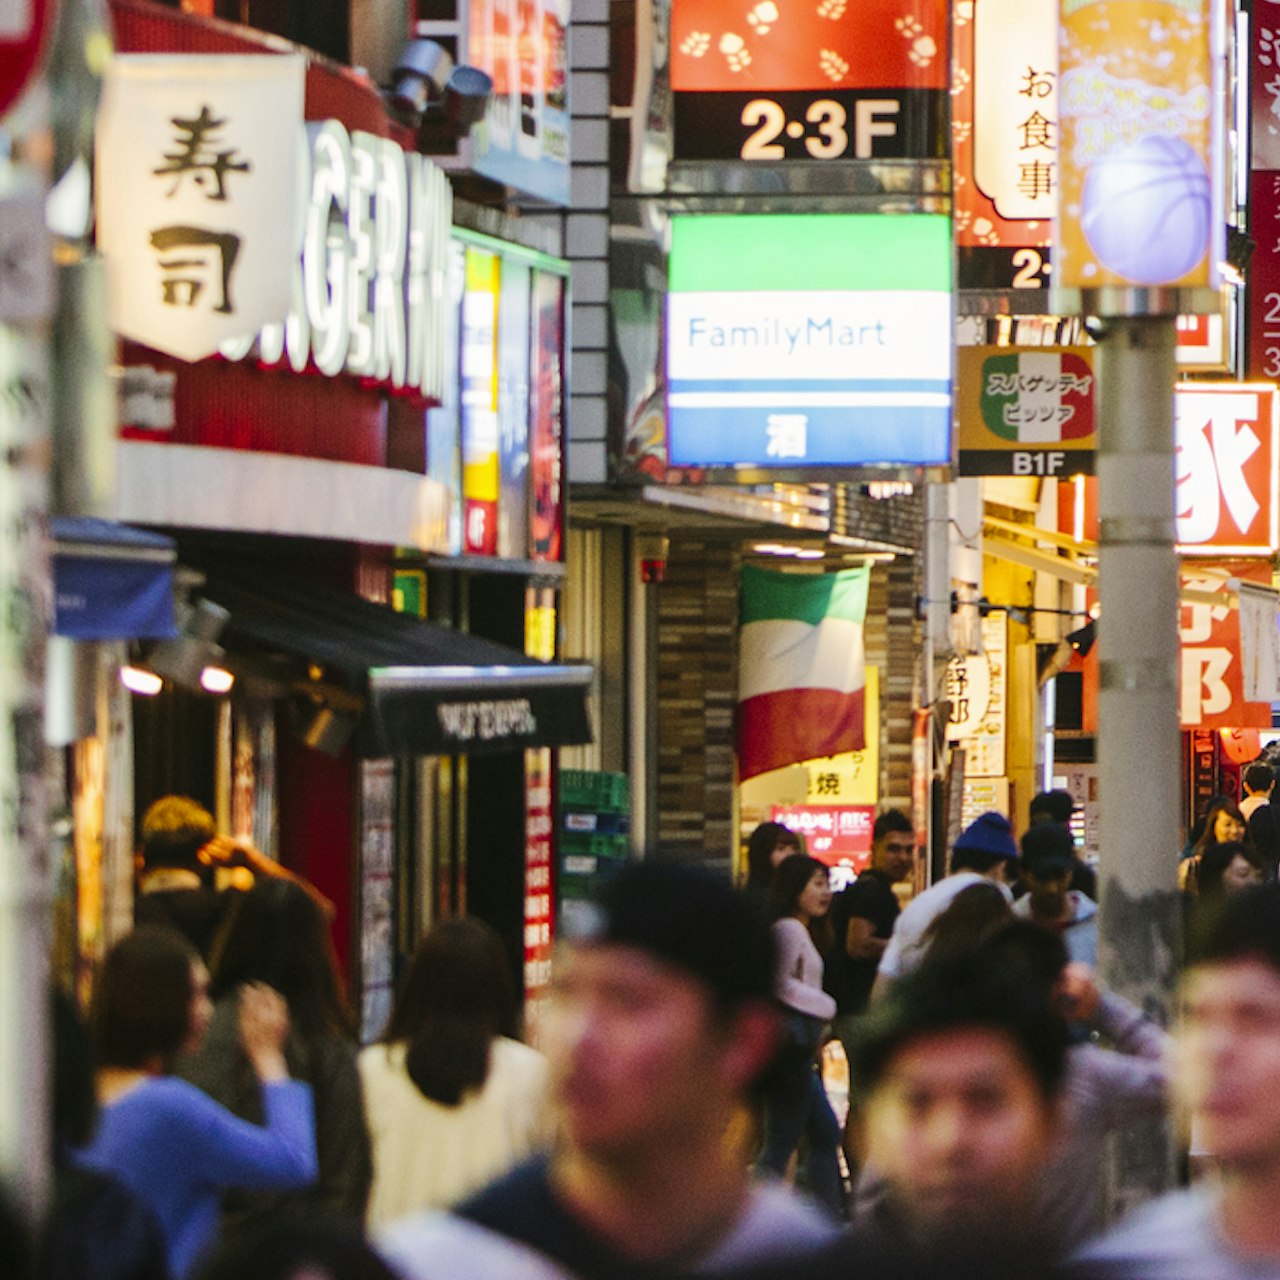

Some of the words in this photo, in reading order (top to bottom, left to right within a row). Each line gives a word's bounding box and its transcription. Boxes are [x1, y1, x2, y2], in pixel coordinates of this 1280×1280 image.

[1017, 68, 1057, 201] お食事
[151, 106, 250, 315] 寿司
[688, 316, 887, 355] FamilyMart
[1012, 452, 1066, 476] B1F
